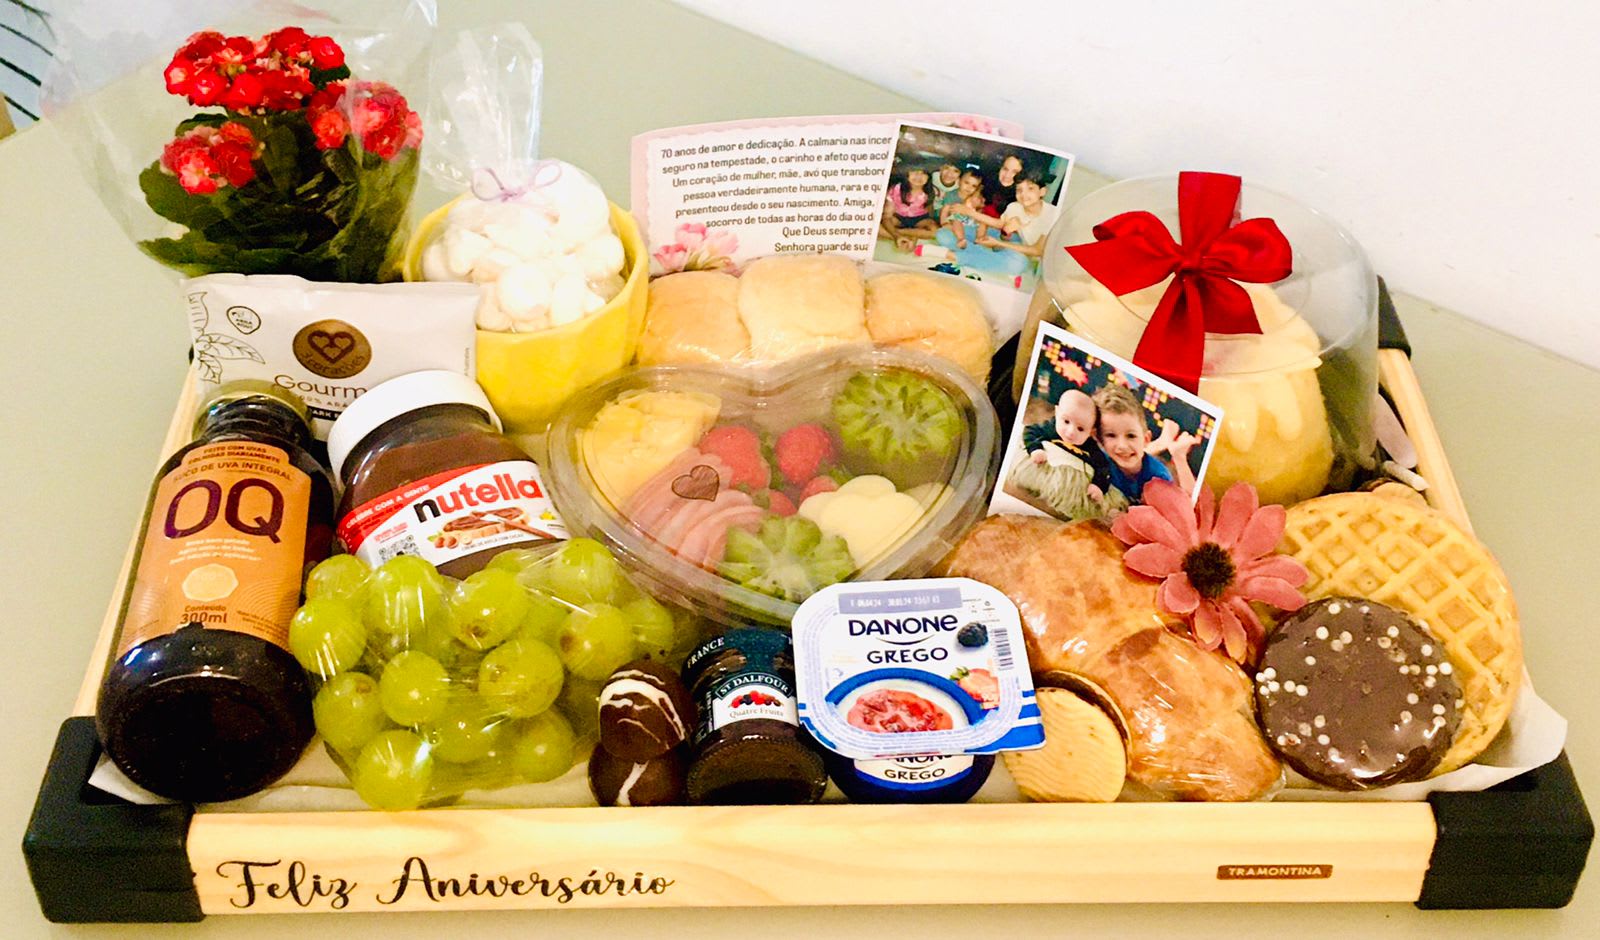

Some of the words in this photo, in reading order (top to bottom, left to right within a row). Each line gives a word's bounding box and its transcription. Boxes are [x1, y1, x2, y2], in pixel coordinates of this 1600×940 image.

[661, 148, 673, 159] 70
[674, 147, 696, 157] anos
[698, 144, 710, 154] de
[711, 144, 736, 153] amor
[746, 138, 797, 150] dedicação.
[799, 138, 806, 147] A
[807, 137, 848, 147] calmaria
[850, 137, 867, 145] nas
[662, 163, 696, 175] seguro
[697, 161, 709, 169] na
[710, 155, 769, 168] tempestade,
[779, 153, 815, 163] carinho
[824, 152, 849, 162] afeto
[850, 153, 868, 163] que
[672, 178, 687, 188] Um
[689, 173, 728, 185] coração
[730, 172, 741, 181] de
[743, 170, 777, 180] mulher,
[803, 167, 819, 177] avó
[821, 169, 838, 178] que
[683, 190, 716, 203] pessoa
[717, 185, 797, 197] verdadeiramente
[799, 184, 839, 193] humana,
[841, 184, 862, 192] rara
[675, 204, 729, 218] presenteou
[731, 202, 758, 211] desde
[768, 201, 784, 209] seu
[786, 199, 841, 208] nascimento.
[843, 198, 875, 208] Amiga,
[705, 218, 743, 228] socorro
[744, 216, 756, 225] de
[758, 215, 784, 224] todas
[785, 215, 796, 223] as
[797, 213, 824, 222] horas
[826, 213, 837, 221] do
[839, 212, 852, 221] dia
[854, 213, 865, 221] ou
[782, 227, 801, 237] Que
[803, 226, 827, 235] Deus
[829, 227, 865, 237] sempre
[775, 242, 815, 252] Senhora
[817, 242, 852, 254] guarde
[274, 374, 368, 399] Gourm
[310, 408, 332, 418] ARK
[201, 463, 214, 472] DE
[242, 462, 291, 480] INTEGRAL
[413, 473, 544, 523] nutella
[164, 478, 285, 544] OQ
[180, 612, 227, 625] 300ml
[687, 636, 725, 669] FRANCE
[867, 647, 948, 664] GREGO
[720, 682, 732, 695] ST
[733, 674, 789, 693] DALFOUR
[729, 708, 758, 719] Quatre
[760, 708, 784, 717] Fruits
[884, 768, 945, 780] GREGO
[1228, 867, 1321, 876] TRAMONTINA
[216, 858, 358, 910] Feliz
[376, 855, 676, 905] Aniversário
